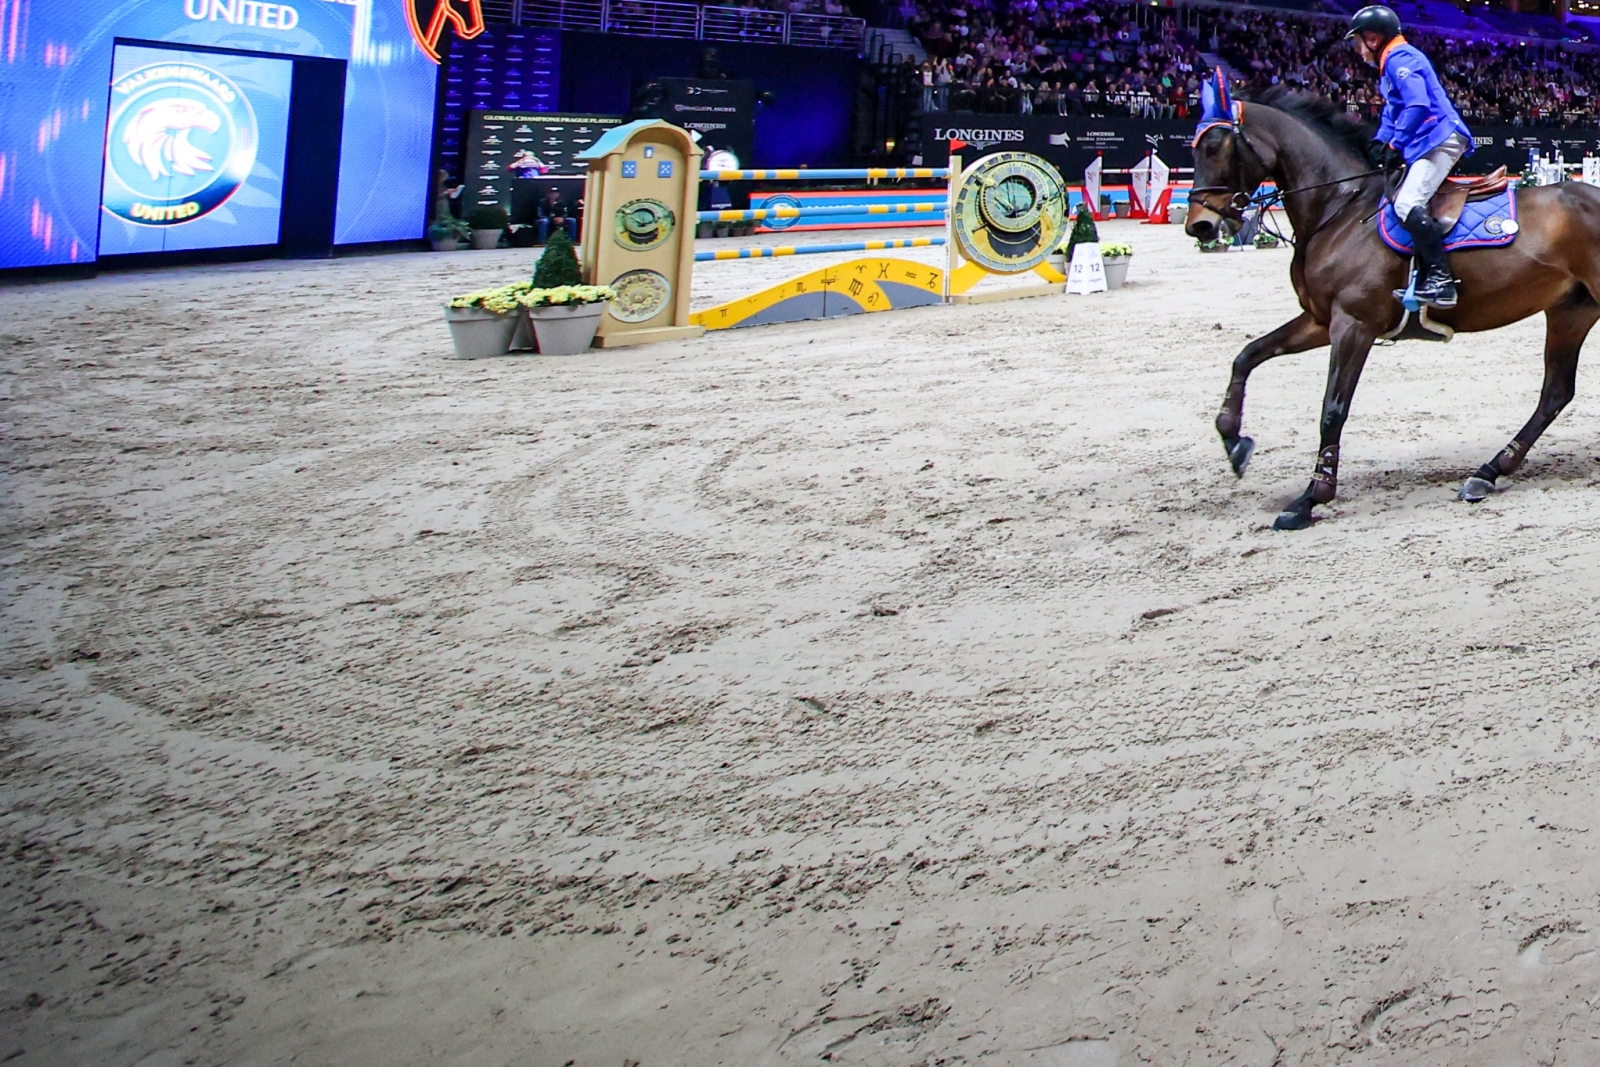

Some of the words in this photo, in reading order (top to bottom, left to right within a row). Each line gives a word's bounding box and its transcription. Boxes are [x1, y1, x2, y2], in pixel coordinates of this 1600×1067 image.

[112, 66, 236, 103] VALKENSWAARD
[515, 115, 561, 123] CHAMPIONS
[934, 128, 1025, 141] LONGINES
[131, 202, 200, 221] UNITED
[1074, 264, 1083, 274] 12
[1090, 263, 1101, 273] 12
